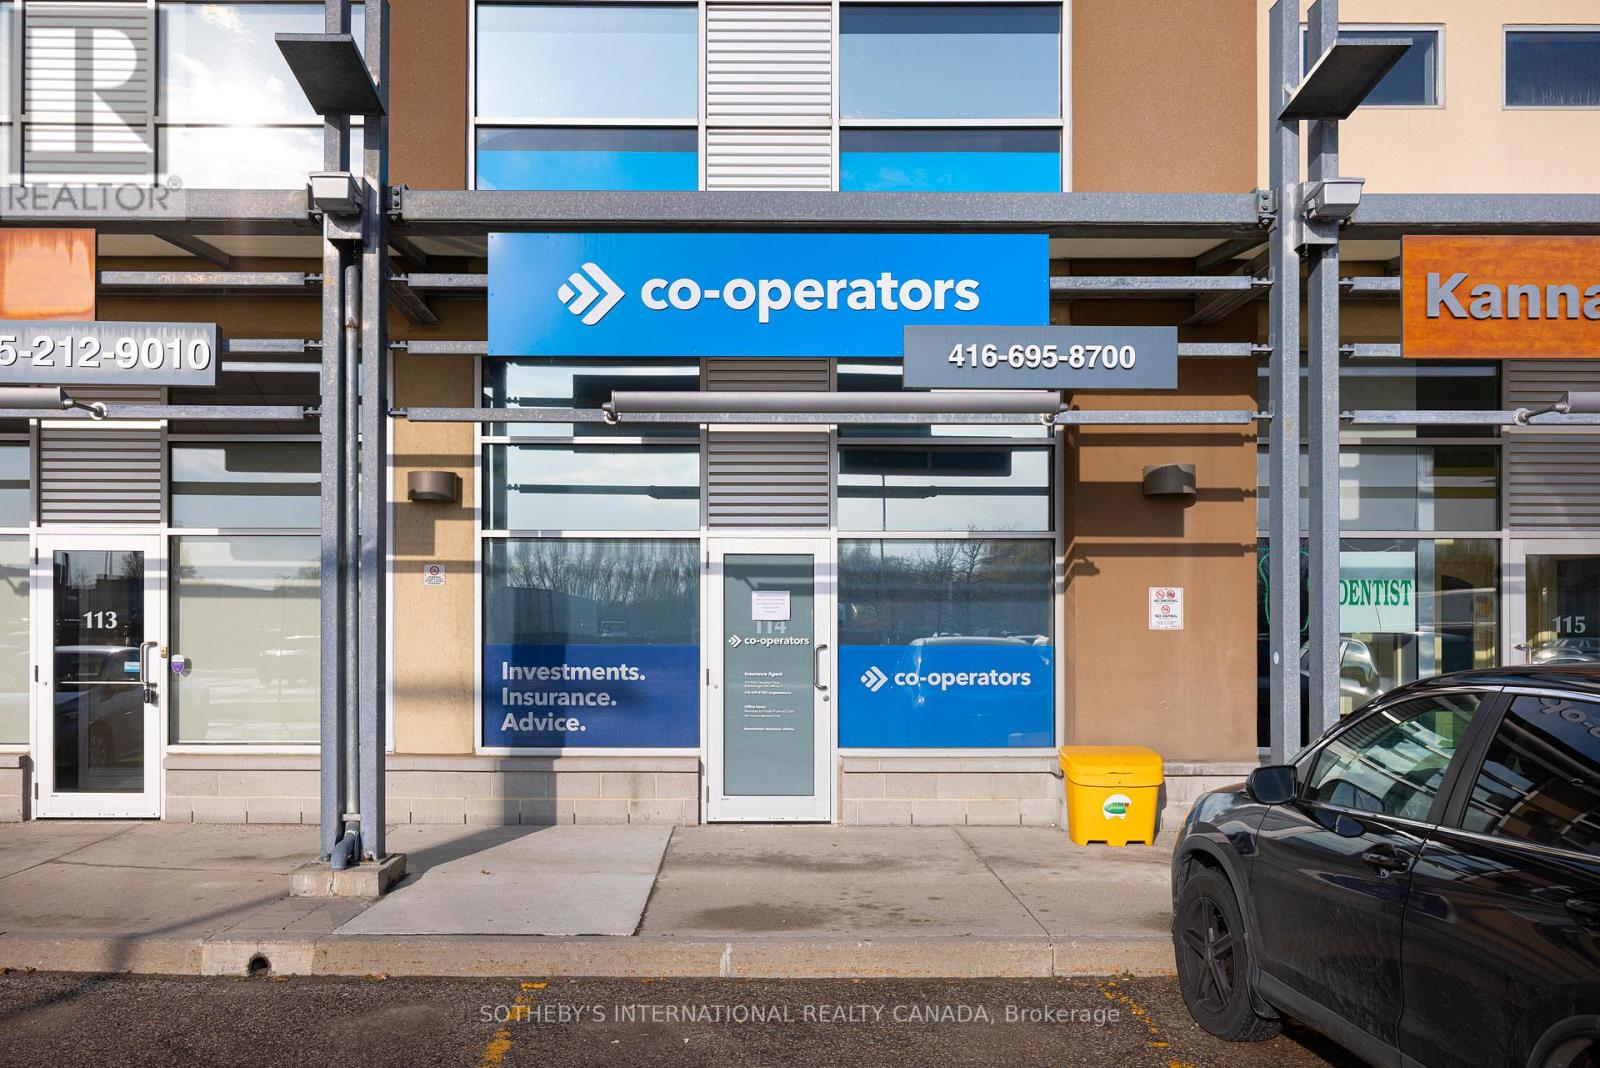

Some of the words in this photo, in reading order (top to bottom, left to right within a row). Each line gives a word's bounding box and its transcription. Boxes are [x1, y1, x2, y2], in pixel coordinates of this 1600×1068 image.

[641, 272, 980, 324] co-operators
[0, 335, 211, 371] 5-212-9010
[948, 343, 1136, 369] 416-695-8700
[1339, 579, 1412, 606] DENTIST
[83, 611, 118, 629] 113
[1552, 615, 1586, 634] 115
[744, 636, 810, 647] co-operators
[502, 661, 646, 681] Investments.
[894, 669, 1031, 691] co-operators
[502, 687, 617, 706] Insurance.
[501, 712, 586, 731] Advice.
